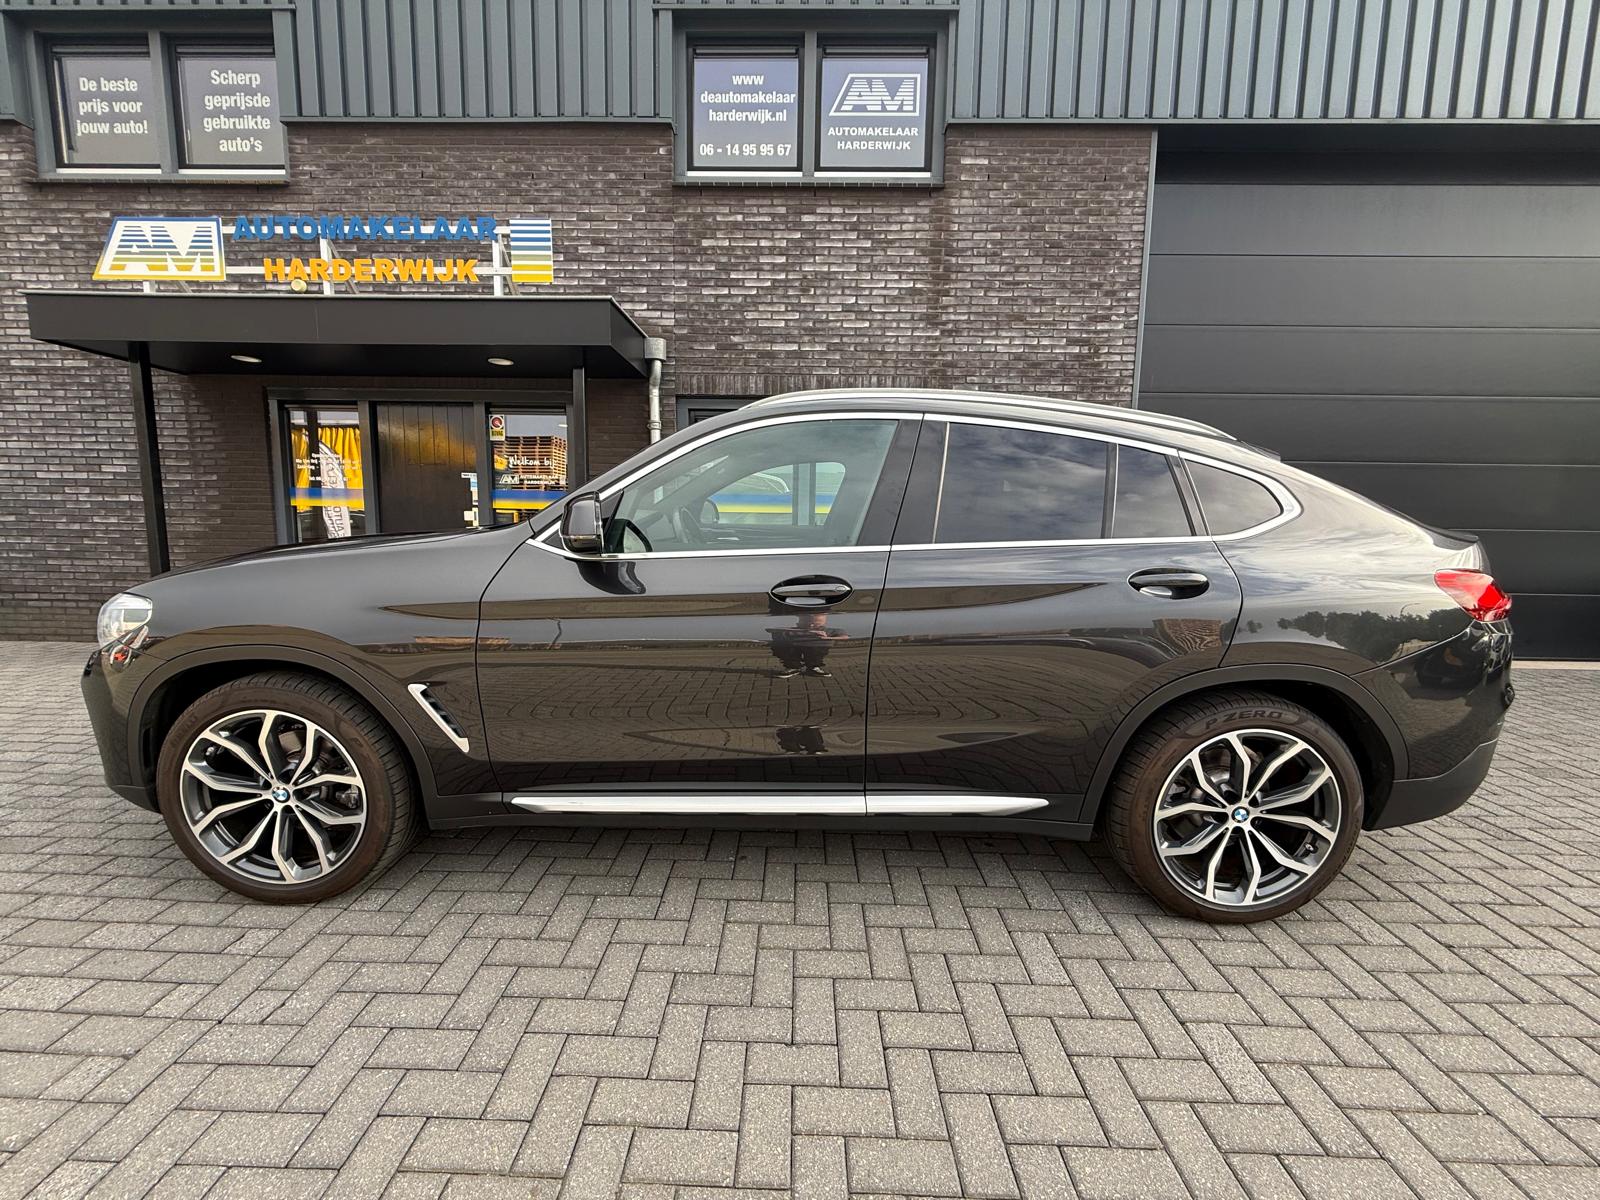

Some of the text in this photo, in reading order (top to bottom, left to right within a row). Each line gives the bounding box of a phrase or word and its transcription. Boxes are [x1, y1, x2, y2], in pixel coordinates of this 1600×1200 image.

[79, 78, 137, 92] De beste
[210, 70, 261, 87] Scherp
[732, 75, 764, 85] www
[204, 93, 271, 110] geprijsde
[700, 90, 796, 104] deautomakelaar
[839, 79, 915, 111] AM
[79, 98, 143, 115] prijs voor
[203, 115, 271, 132] gebruikte
[708, 109, 787, 124] harderwijk.nl
[76, 119, 148, 136] jouw auto!
[827, 126, 919, 137] AUTOMAKELAAR
[219, 136, 263, 152] auto's
[699, 143, 713, 156] 06
[725, 143, 740, 156] 14
[742, 143, 757, 156] 95
[759, 143, 774, 156] 95
[776, 143, 792, 156] 67
[836, 140, 911, 151] HARDERWIJK
[232, 215, 498, 241] AUTOMAKELAAR
[107, 224, 217, 273] AM
[262, 257, 480, 283] HARDERWIJK
[1222, 709, 1284, 722] ZERO
